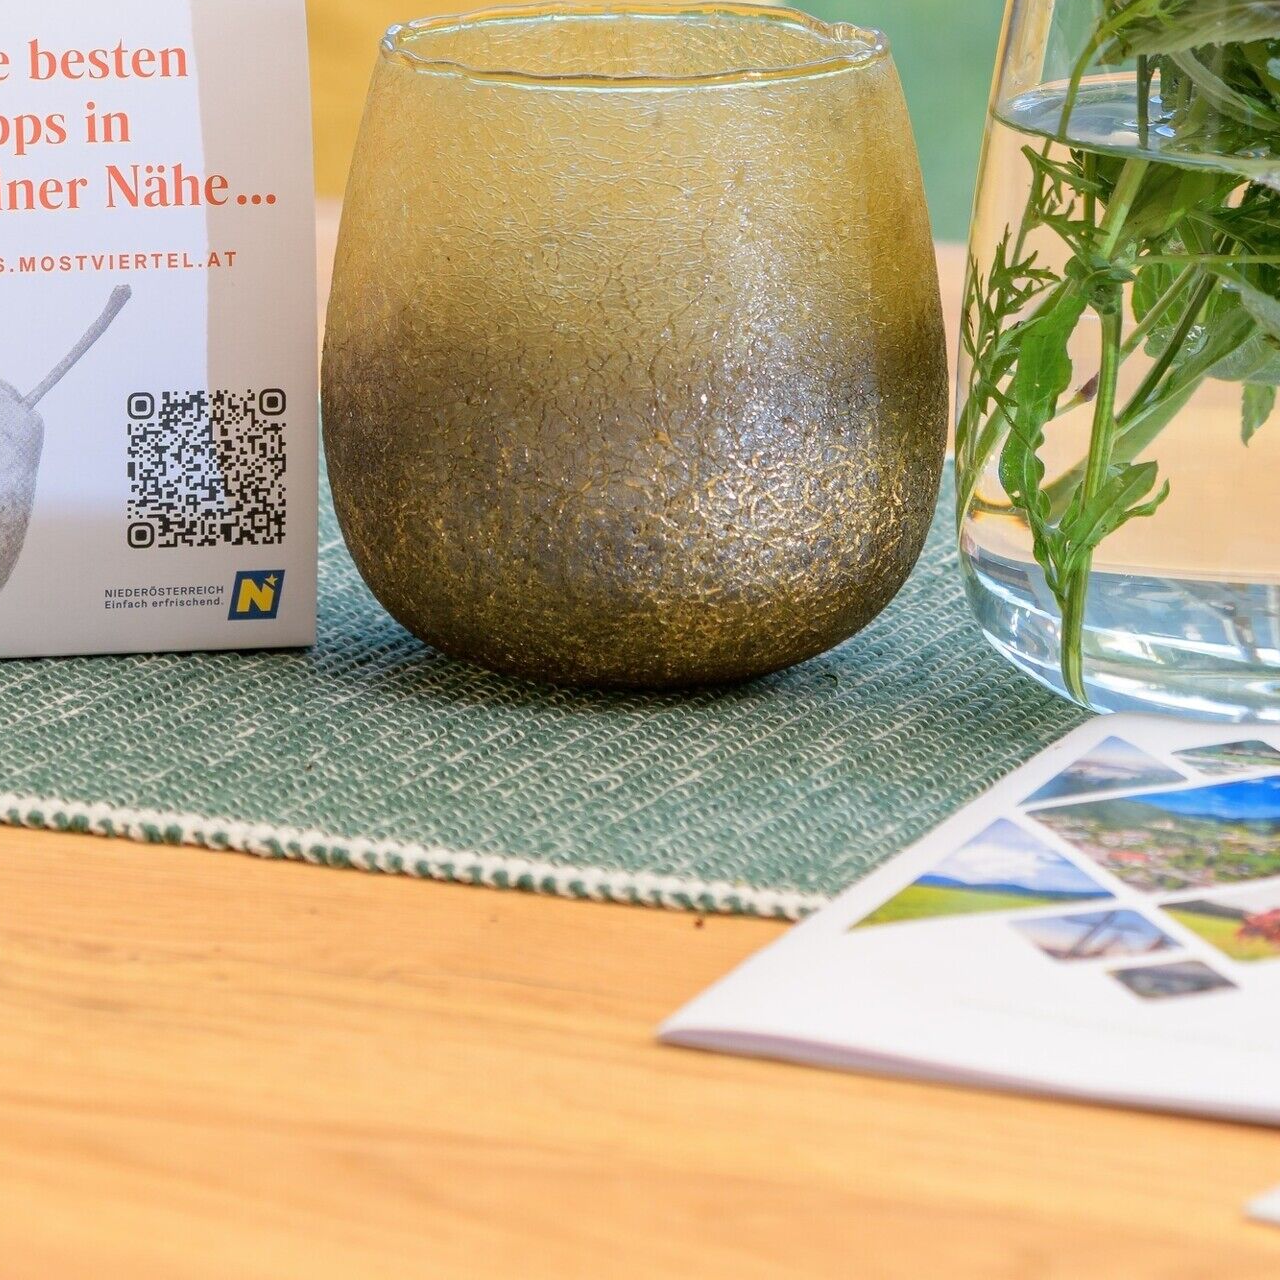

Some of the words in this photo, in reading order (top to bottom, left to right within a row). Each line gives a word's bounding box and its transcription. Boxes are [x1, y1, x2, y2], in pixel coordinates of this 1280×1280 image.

[28, 38, 188, 81] besten
[85, 101, 131, 144] in
[105, 163, 277, 209] Nähe...
[104, 585, 225, 599] NIEDERÖSTERREICH
[104, 599, 148, 610] Einfach
[151, 597, 225, 608] erfrischend.
